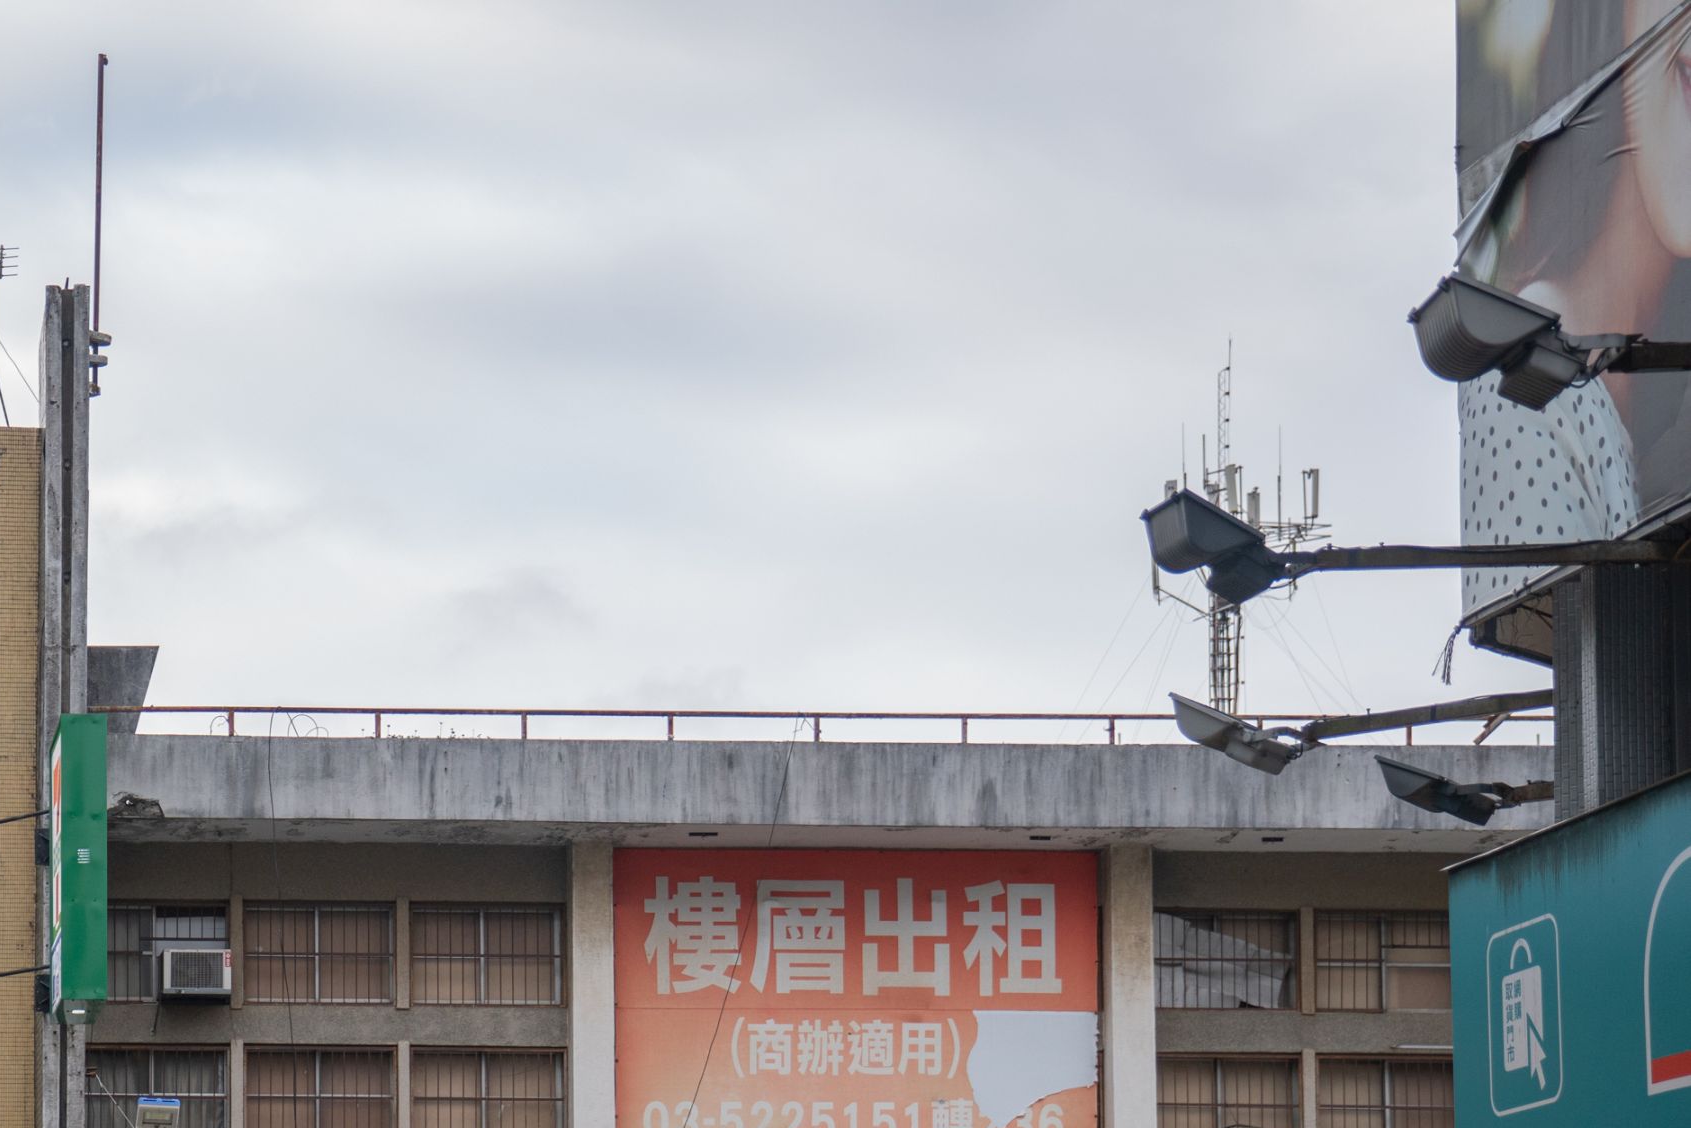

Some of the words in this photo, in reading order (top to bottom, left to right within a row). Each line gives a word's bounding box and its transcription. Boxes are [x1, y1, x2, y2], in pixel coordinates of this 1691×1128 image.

[644, 875, 1062, 997] 樓層出租
[731, 1016, 962, 1079] (商辦適用)
